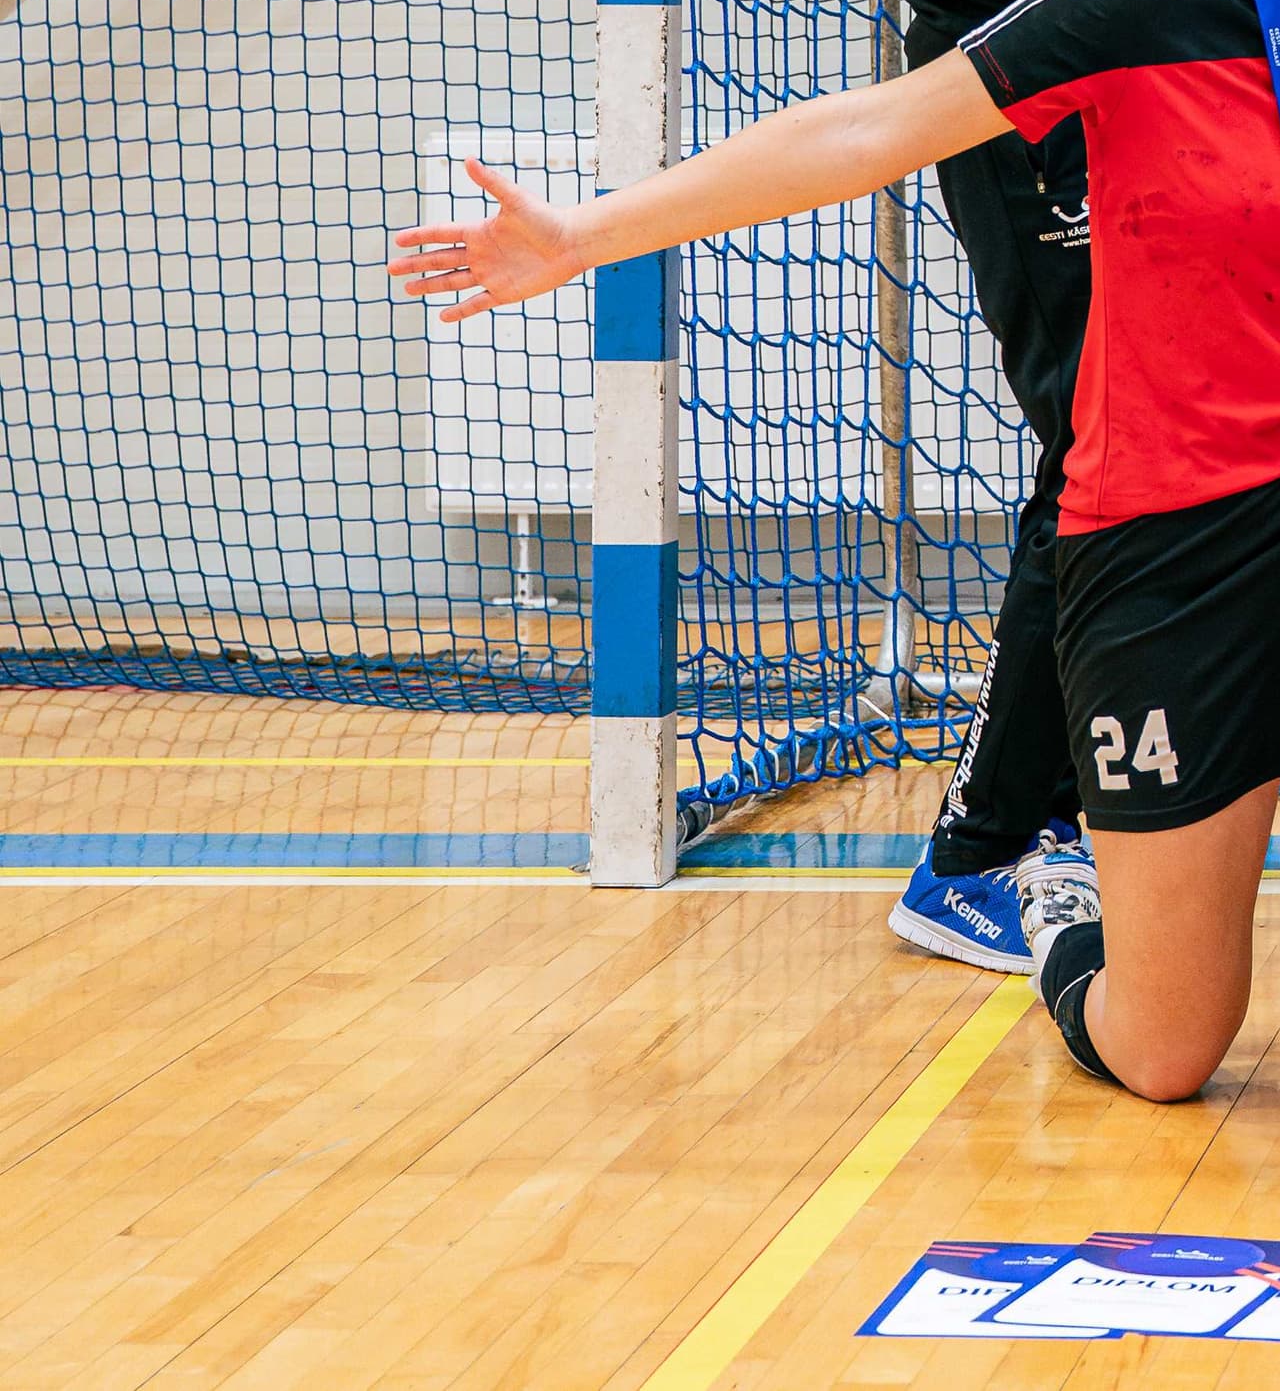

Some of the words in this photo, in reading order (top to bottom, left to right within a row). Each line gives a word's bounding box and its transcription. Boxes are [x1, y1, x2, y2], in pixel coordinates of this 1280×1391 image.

[1039, 232, 1065, 242] EESTI
[1067, 225, 1091, 238] KÄSI
[1090, 708, 1179, 791] 24
[943, 886, 1004, 941] Kempa
[1072, 1276, 1237, 1294] DIPLOM
